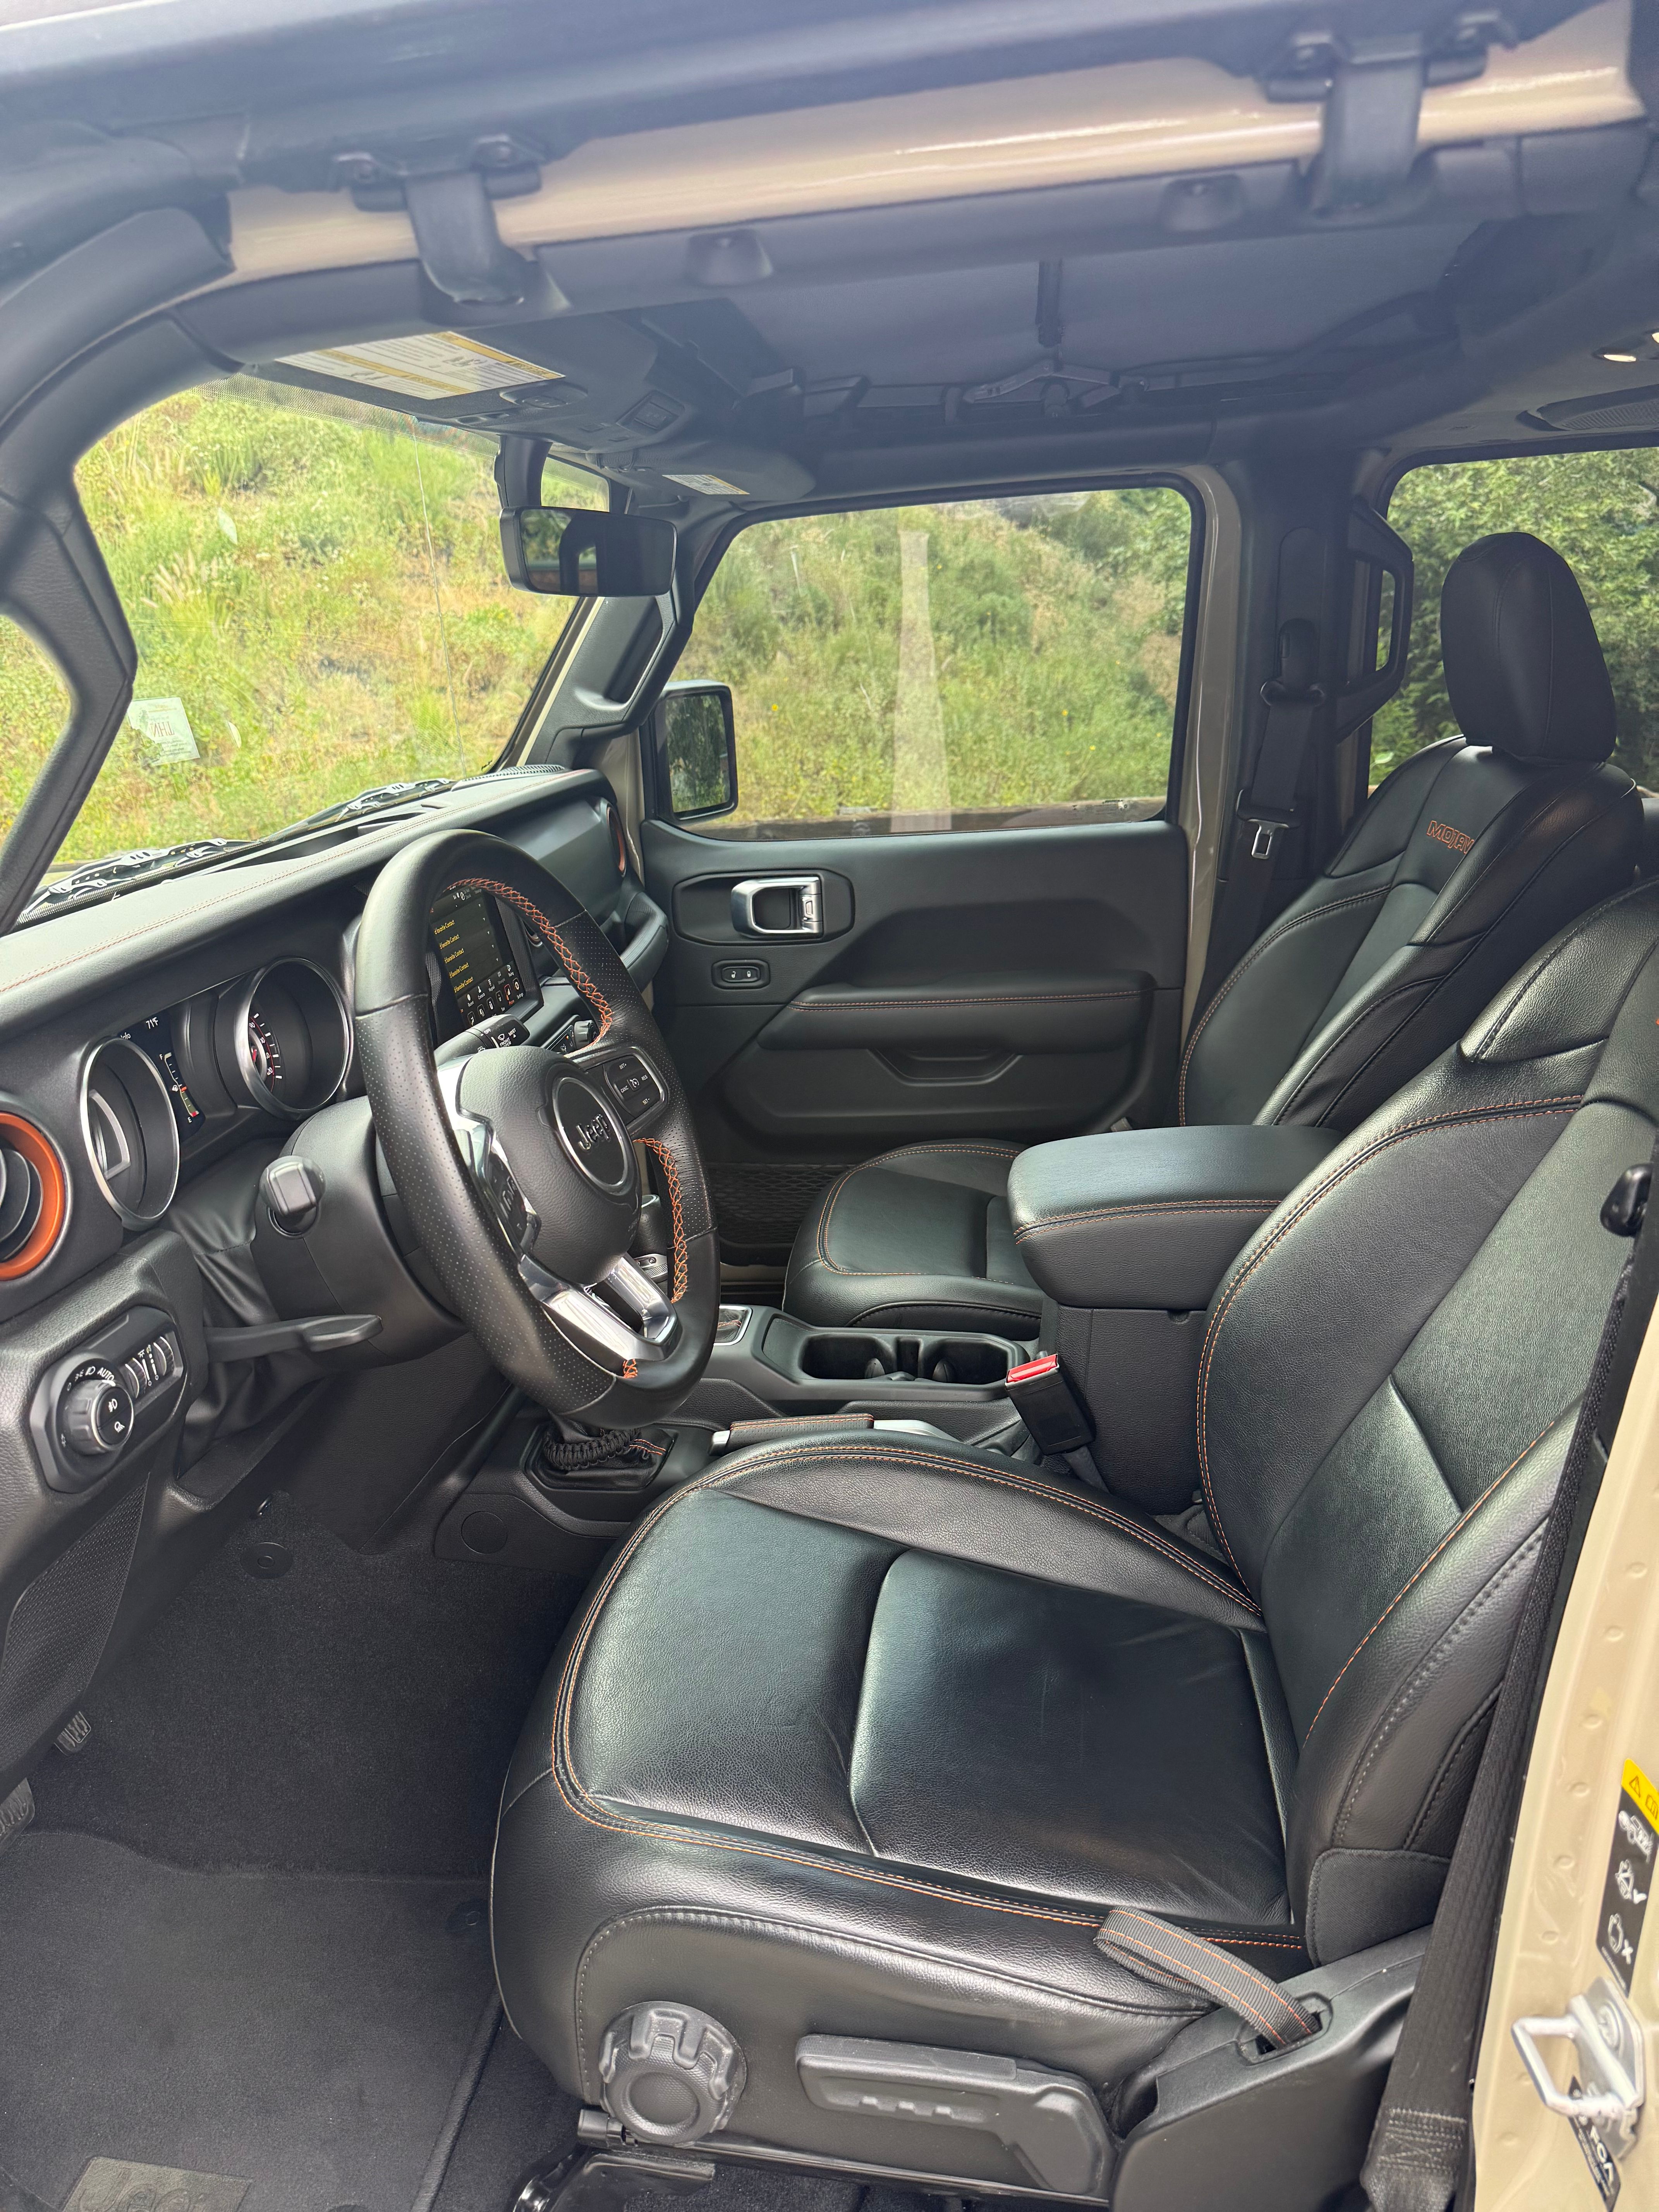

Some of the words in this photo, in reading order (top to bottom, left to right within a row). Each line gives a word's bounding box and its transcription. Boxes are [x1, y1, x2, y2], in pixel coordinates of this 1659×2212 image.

[1427, 820, 1474, 854] MOJAV
[576, 1114, 610, 1150] Jeep
[97, 1367, 115, 1381] AUTO
